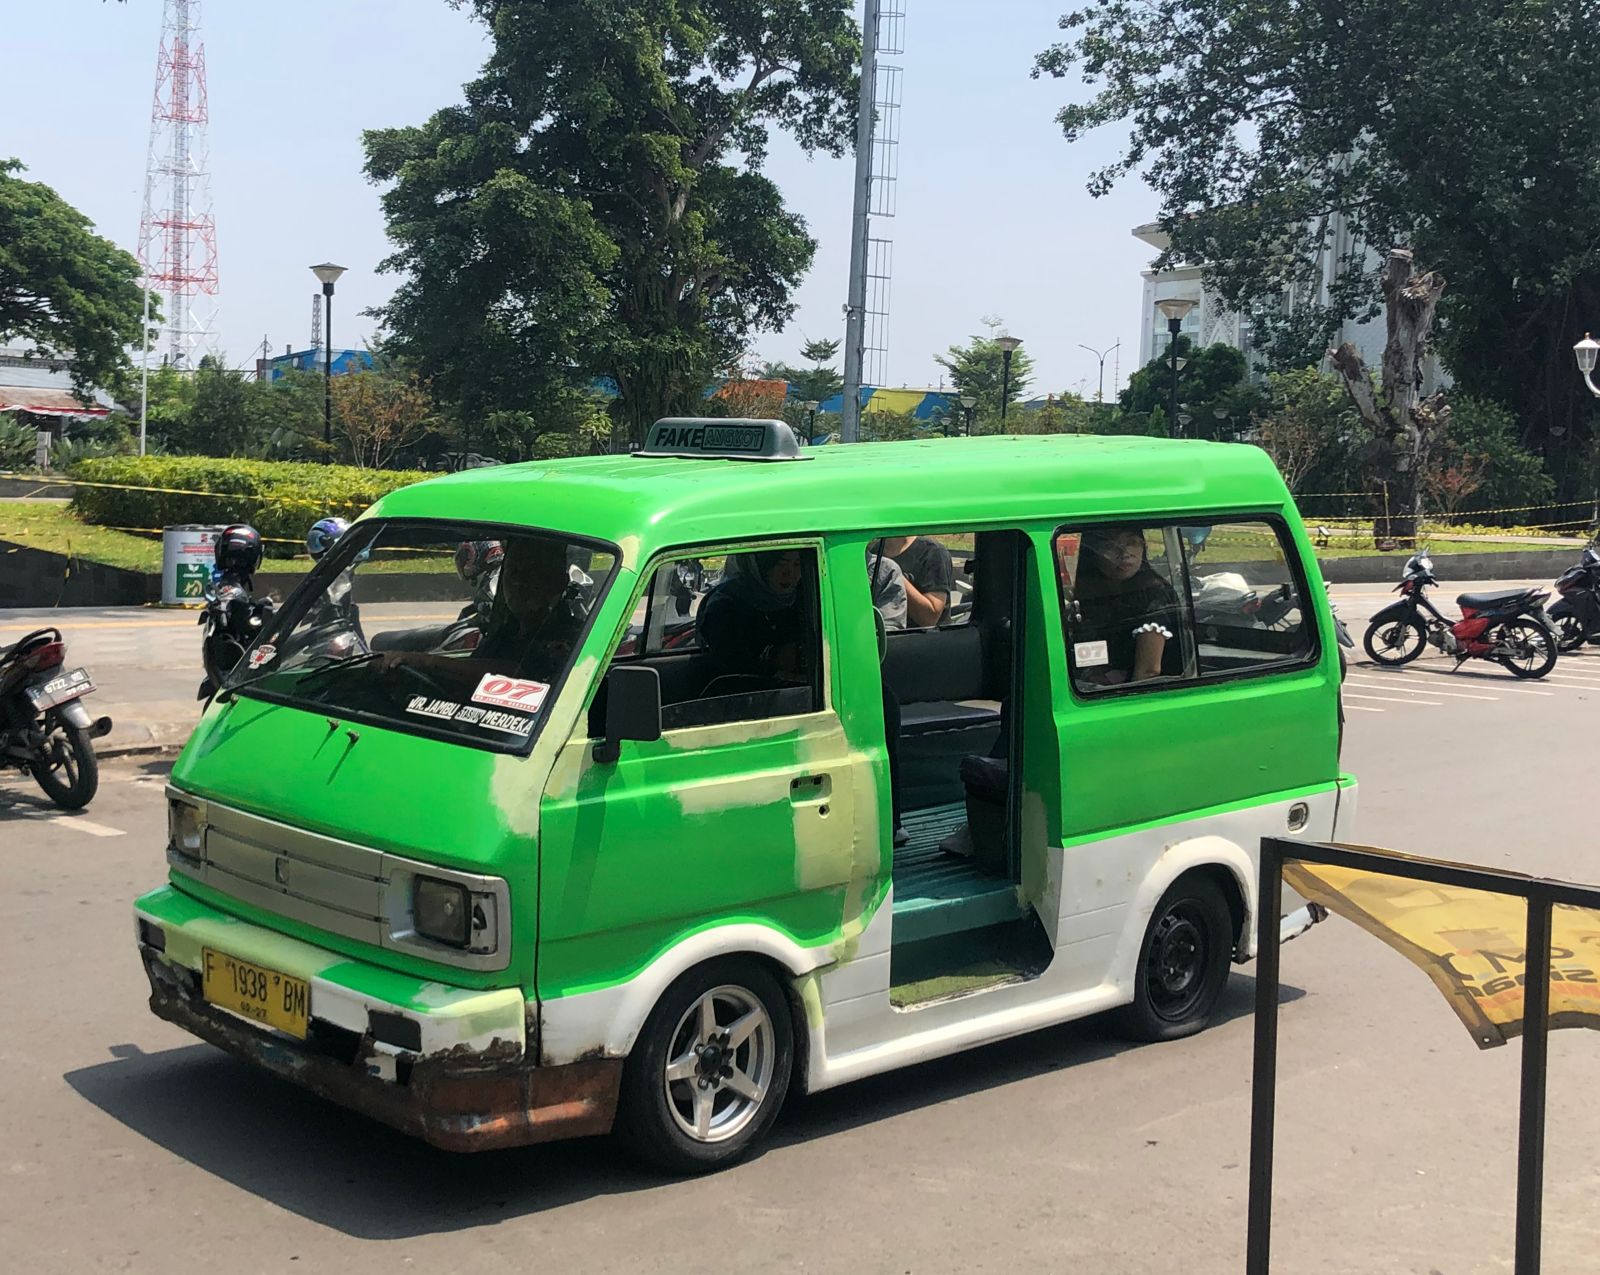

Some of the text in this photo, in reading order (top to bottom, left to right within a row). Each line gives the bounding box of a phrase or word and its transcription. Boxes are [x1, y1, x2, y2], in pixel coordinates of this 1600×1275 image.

[655, 427, 761, 447] FAKE ANGKOT
[483, 680, 543, 700] 07
[426, 699, 460, 716] JAMBU
[481, 711, 534, 733] MERDEKA
[206, 952, 305, 1018] F 1938 BM
